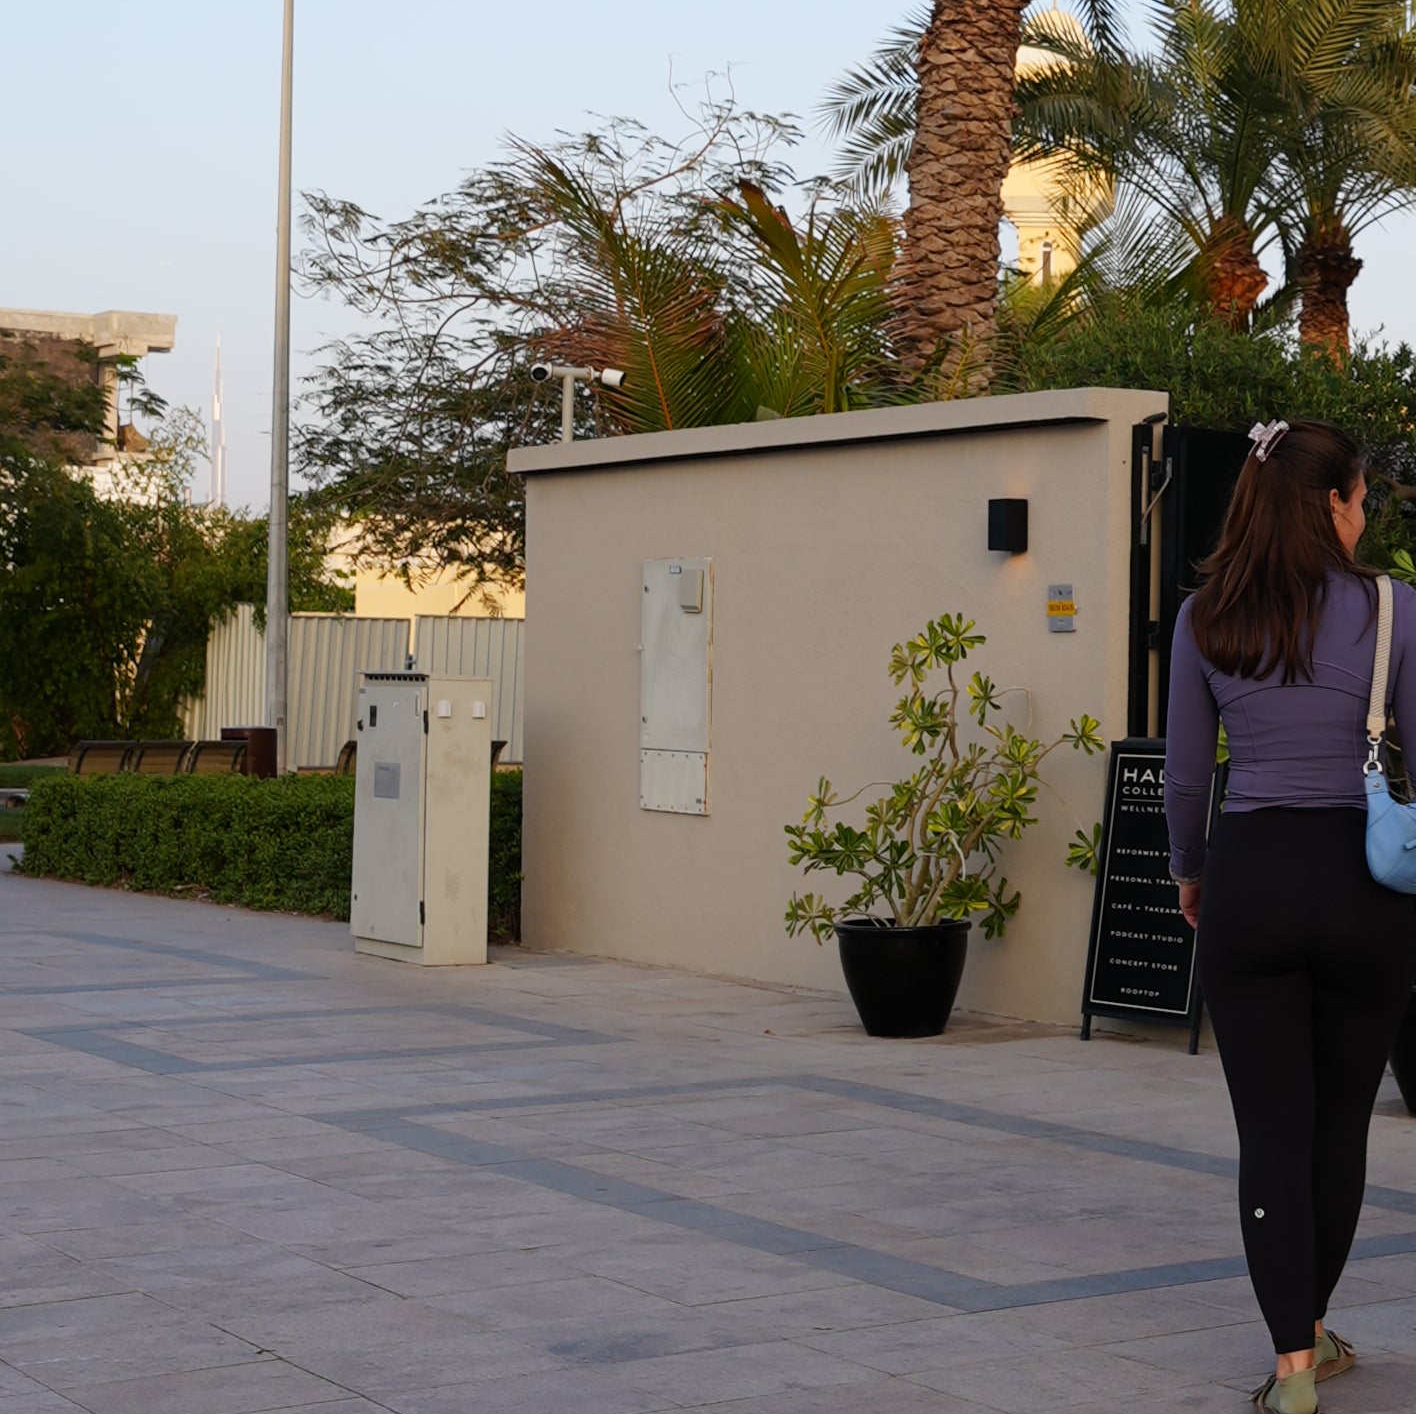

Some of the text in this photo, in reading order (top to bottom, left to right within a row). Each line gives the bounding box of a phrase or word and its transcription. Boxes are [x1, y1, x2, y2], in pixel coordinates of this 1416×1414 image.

[1122, 767, 1165, 784] HAL
[1121, 785, 1164, 797] COLLE
[1116, 847, 1160, 856] REFORMER
[1110, 874, 1152, 884] PERSONAL
[1145, 905, 1183, 914] TAKEAWA
[1110, 929, 1184, 943] PODCAST STUDIO
[1109, 956, 1179, 971] CONCEPT STORE
[1120, 986, 1161, 997] ROOFTOP
